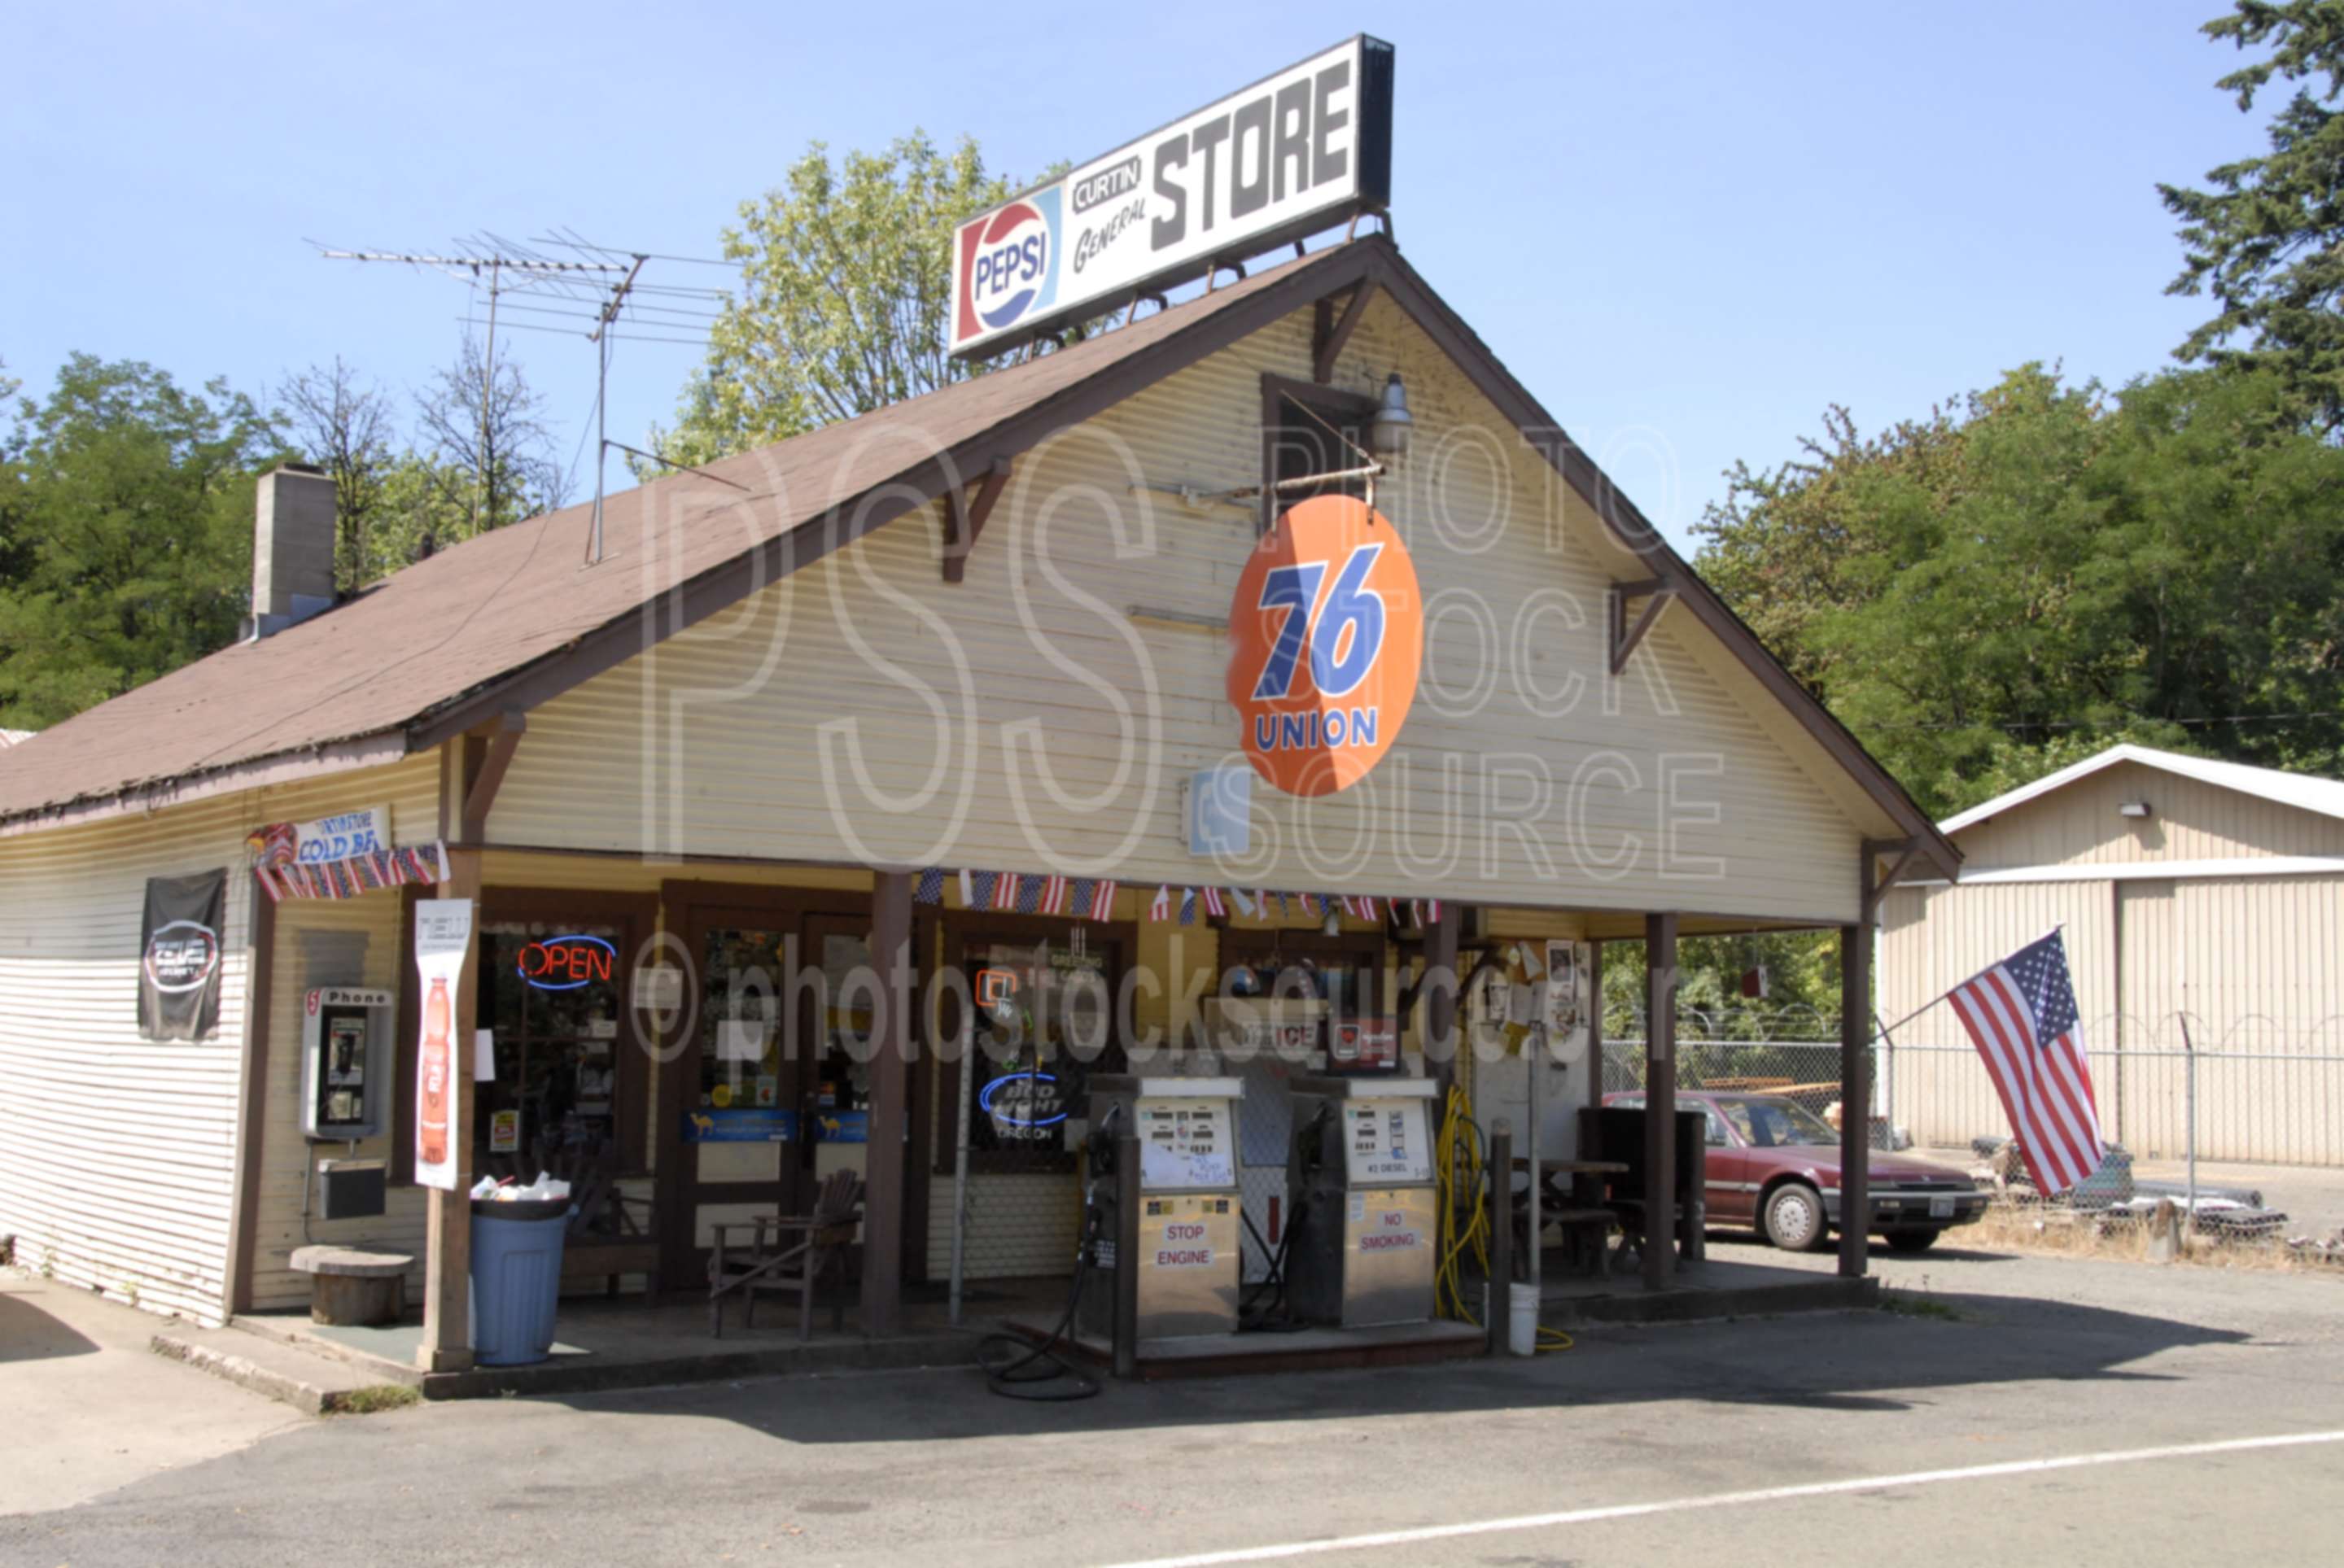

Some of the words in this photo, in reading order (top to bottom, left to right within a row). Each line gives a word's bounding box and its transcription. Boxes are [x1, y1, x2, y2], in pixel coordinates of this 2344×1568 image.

[1150, 59, 1350, 251] STORE
[1074, 159, 1139, 209] CURTIN
[1074, 197, 1145, 274] GENERAL
[976, 234, 1045, 301] PEPSI
[1249, 542, 1386, 702] 76
[1254, 706, 1379, 752] UNION
[299, 836, 348, 862] COLD
[518, 942, 612, 981] OPEN
[329, 992, 386, 1004] Phone
[1275, 1026, 1316, 1047] ICE
[1004, 1085, 1056, 1099] BUD
[1381, 1162, 1408, 1173] DIESEL
[1384, 1212, 1402, 1226] NO
[1166, 1225, 1205, 1240] STOP
[1360, 1232, 1415, 1251] SMOKING
[1157, 1249, 1211, 1265] ENGINE
